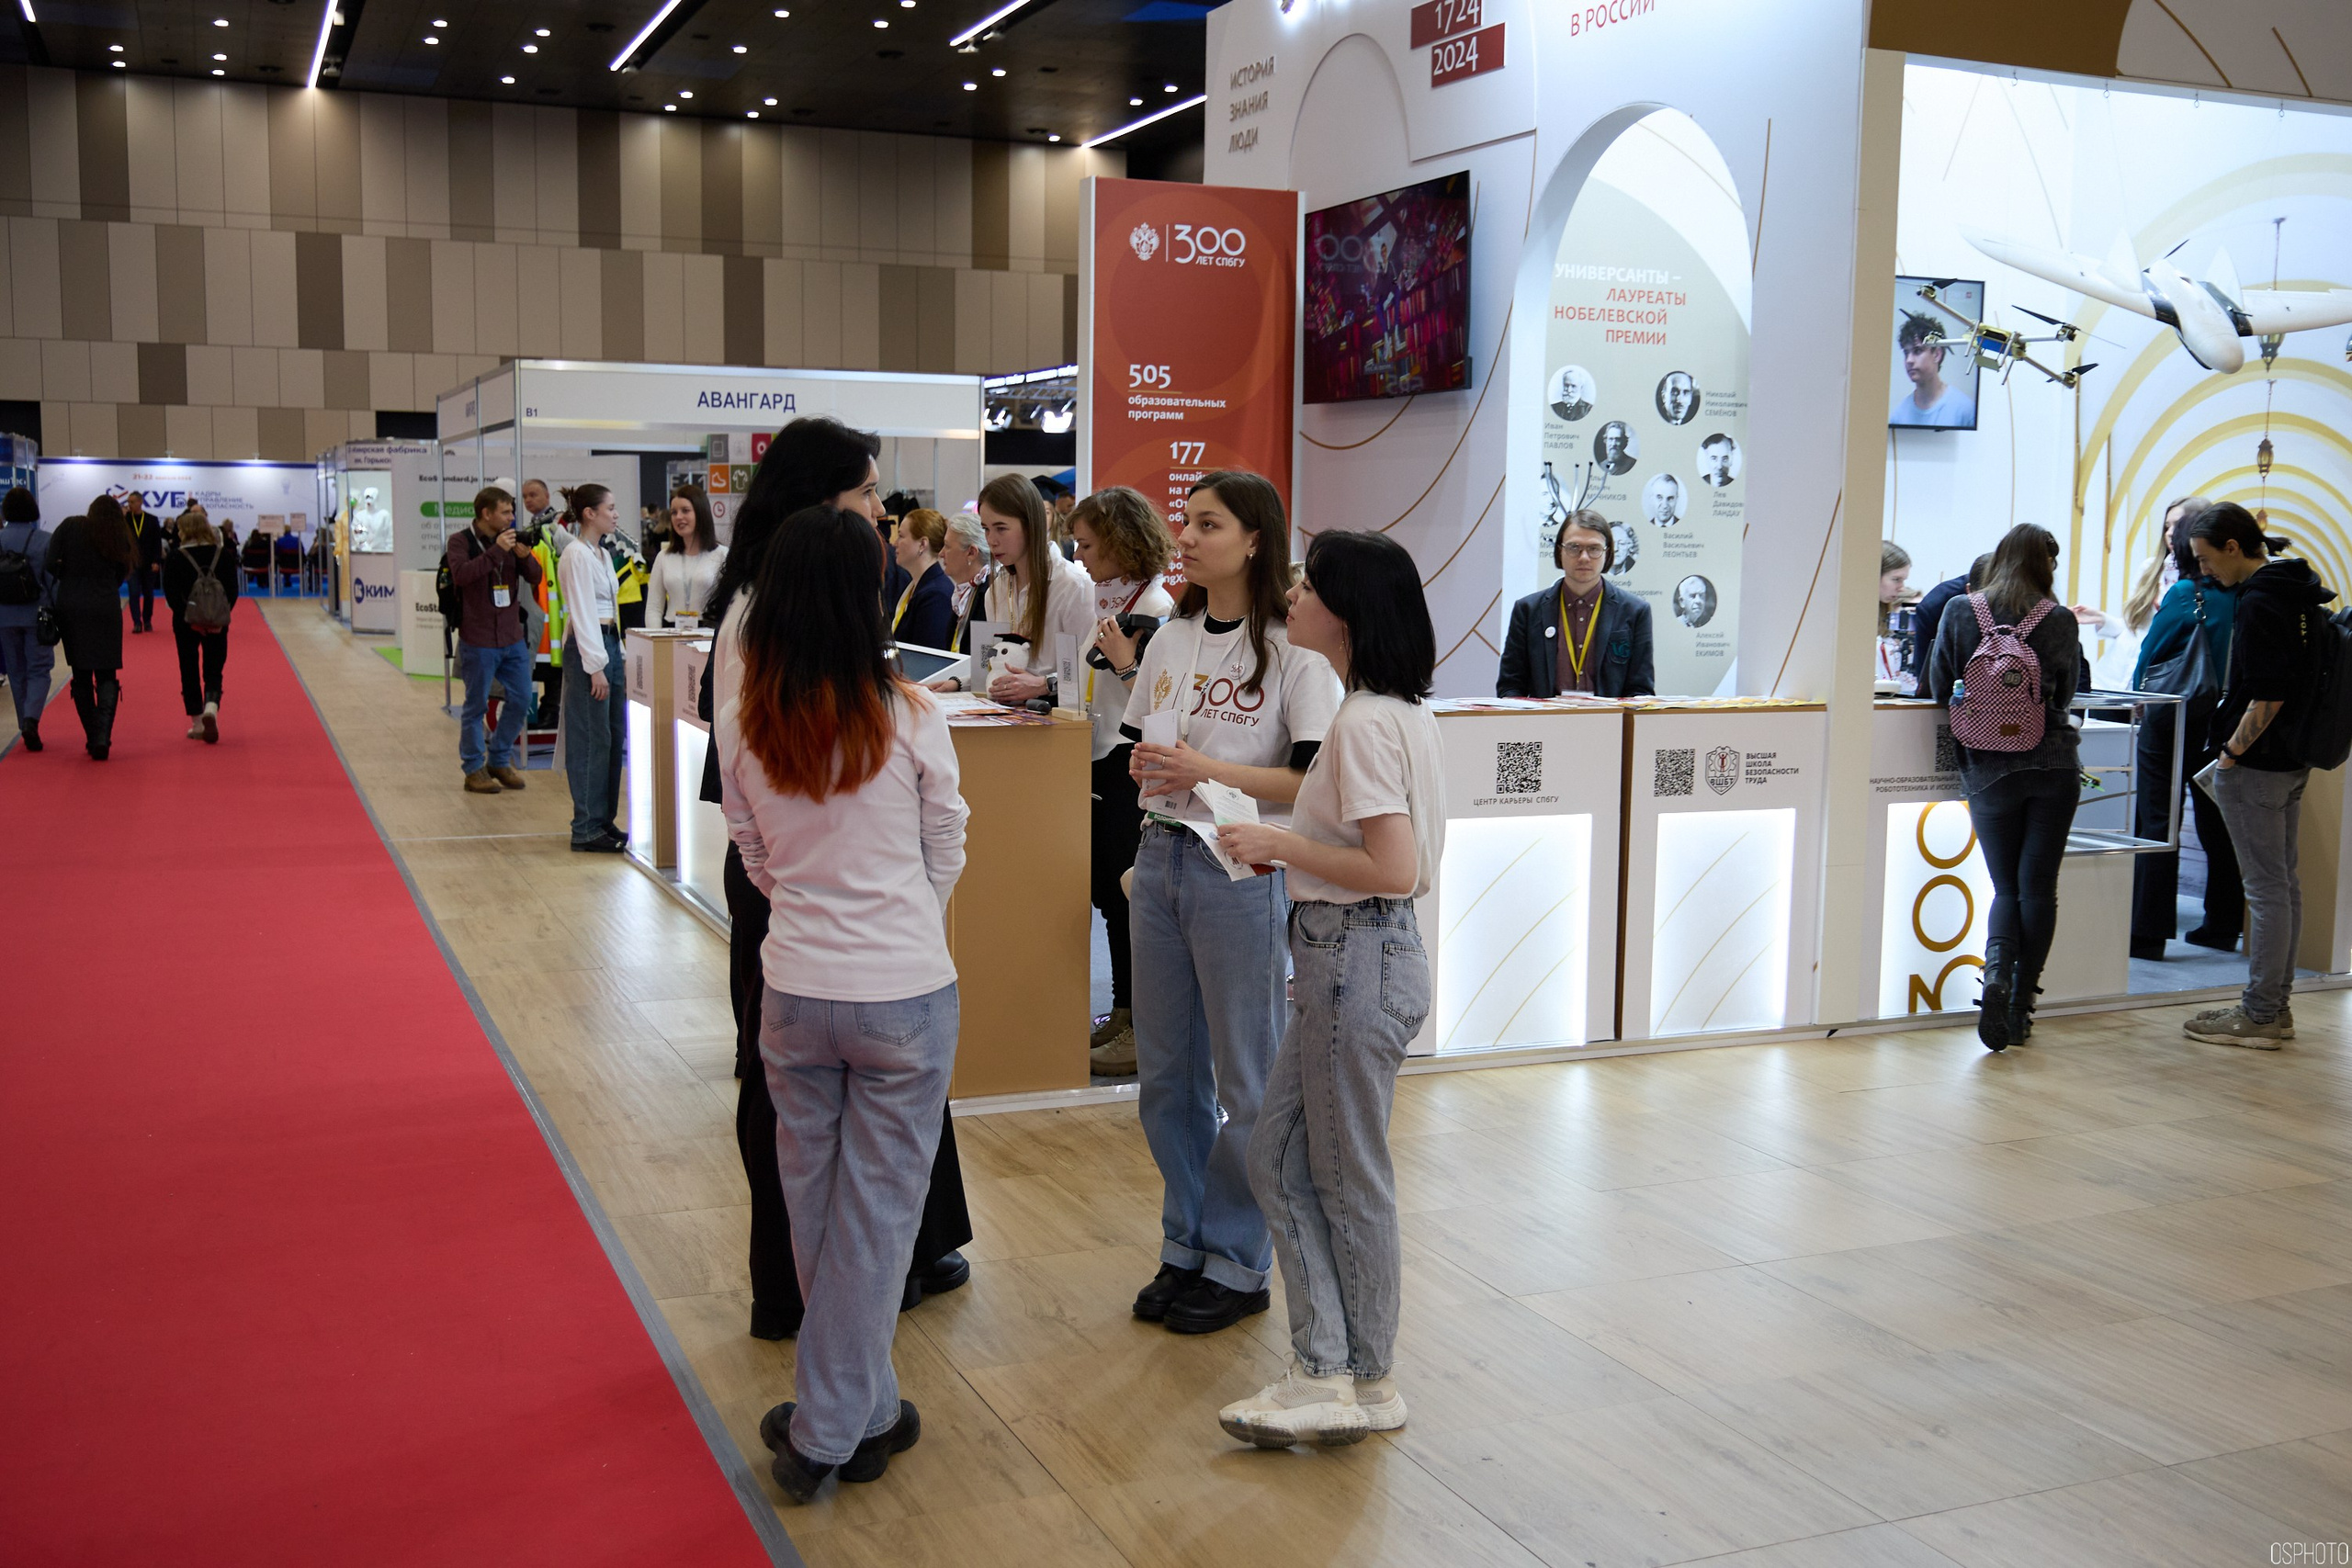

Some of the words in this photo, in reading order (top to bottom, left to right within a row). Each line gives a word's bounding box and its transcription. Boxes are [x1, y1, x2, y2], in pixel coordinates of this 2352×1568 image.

[1435, 0, 1480, 34] 1724
[1570, 13, 1580, 37] В
[1586, 0, 1654, 32] РОССИИ
[1433, 36, 1478, 76] 2024
[1229, 56, 1275, 90] ИСТОРИЯ
[1229, 90, 1269, 122] ЗНАНИЯ
[1228, 127, 1259, 152] ЛЮДИ
[1174, 224, 1246, 264] 300
[1195, 255, 1215, 265] ЛЕТ
[1555, 263, 1669, 285] УНИВЕРСАНТЫ
[1606, 288, 1687, 306] ЛАУРЕАТЫ
[1555, 306, 1668, 325] НОБЕЛЕВСКОЙ
[1605, 329, 1667, 345] ПРЕМИИ
[1129, 364, 1171, 389] 505
[696, 390, 797, 414] АВАНГАРД
[1128, 395, 1227, 409] образовательных
[526, 407, 538, 418] B1
[1128, 410, 1184, 423] программ
[1544, 433, 1580, 441] Петрович
[1170, 441, 1206, 466] 177
[1663, 532, 1694, 540] Василий
[1662, 542, 1704, 550] Васильевич
[415, 602, 439, 613] EcoSt
[1200, 708, 1220, 719] ЛЕТ
[1745, 767, 1800, 776] БЕЗОПАСНОСТИ
[1710, 777, 1734, 786] ВШБТ
[1745, 776, 1768, 785] ТРУДА
[1875, 784, 1928, 793] РОБОТОТЕХНИКА
[1473, 797, 1498, 807] ЦЕНТР
[1498, 796, 1533, 805] КАРЬЕРЫ
